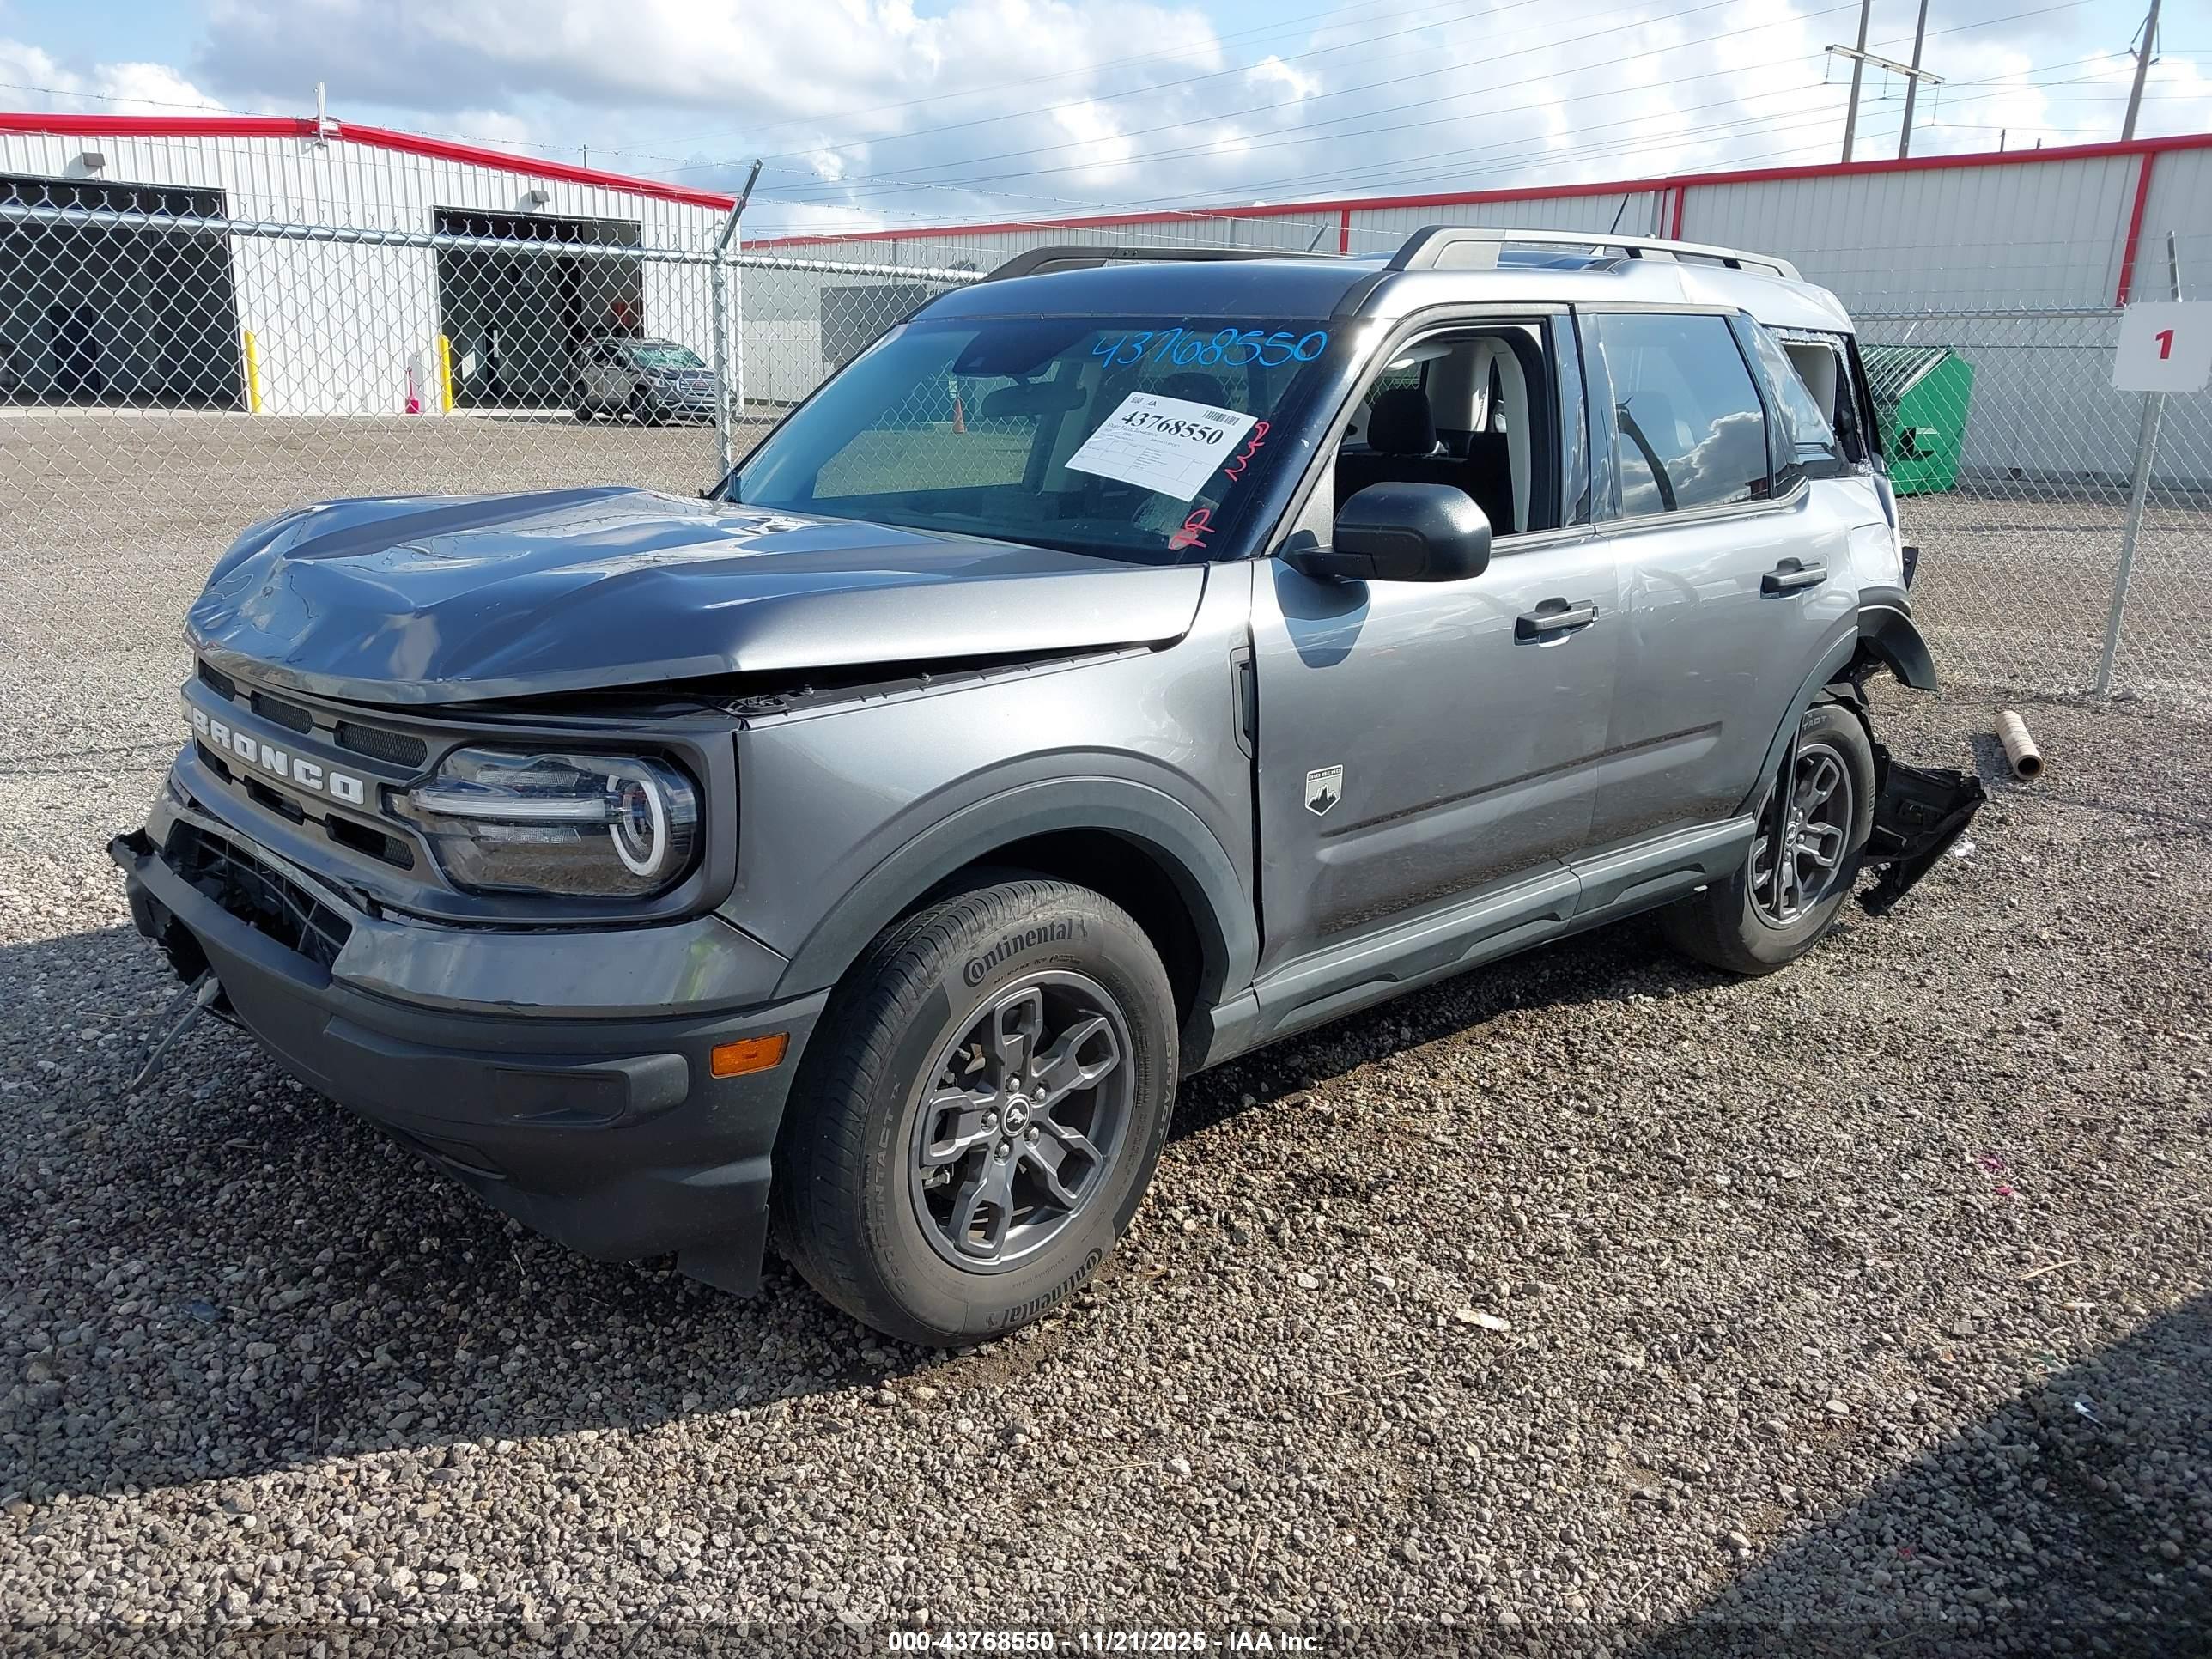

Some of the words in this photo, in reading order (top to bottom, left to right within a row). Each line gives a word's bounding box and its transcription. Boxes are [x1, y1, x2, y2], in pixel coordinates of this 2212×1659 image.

[1091, 327, 1328, 368] 43768550
[2155, 329, 2174, 359] 1
[1121, 410, 1224, 446] 43768550
[192, 707, 364, 805] BRONCO
[963, 918, 1073, 988] Continental
[1000, 1247, 1103, 1328] Continental
